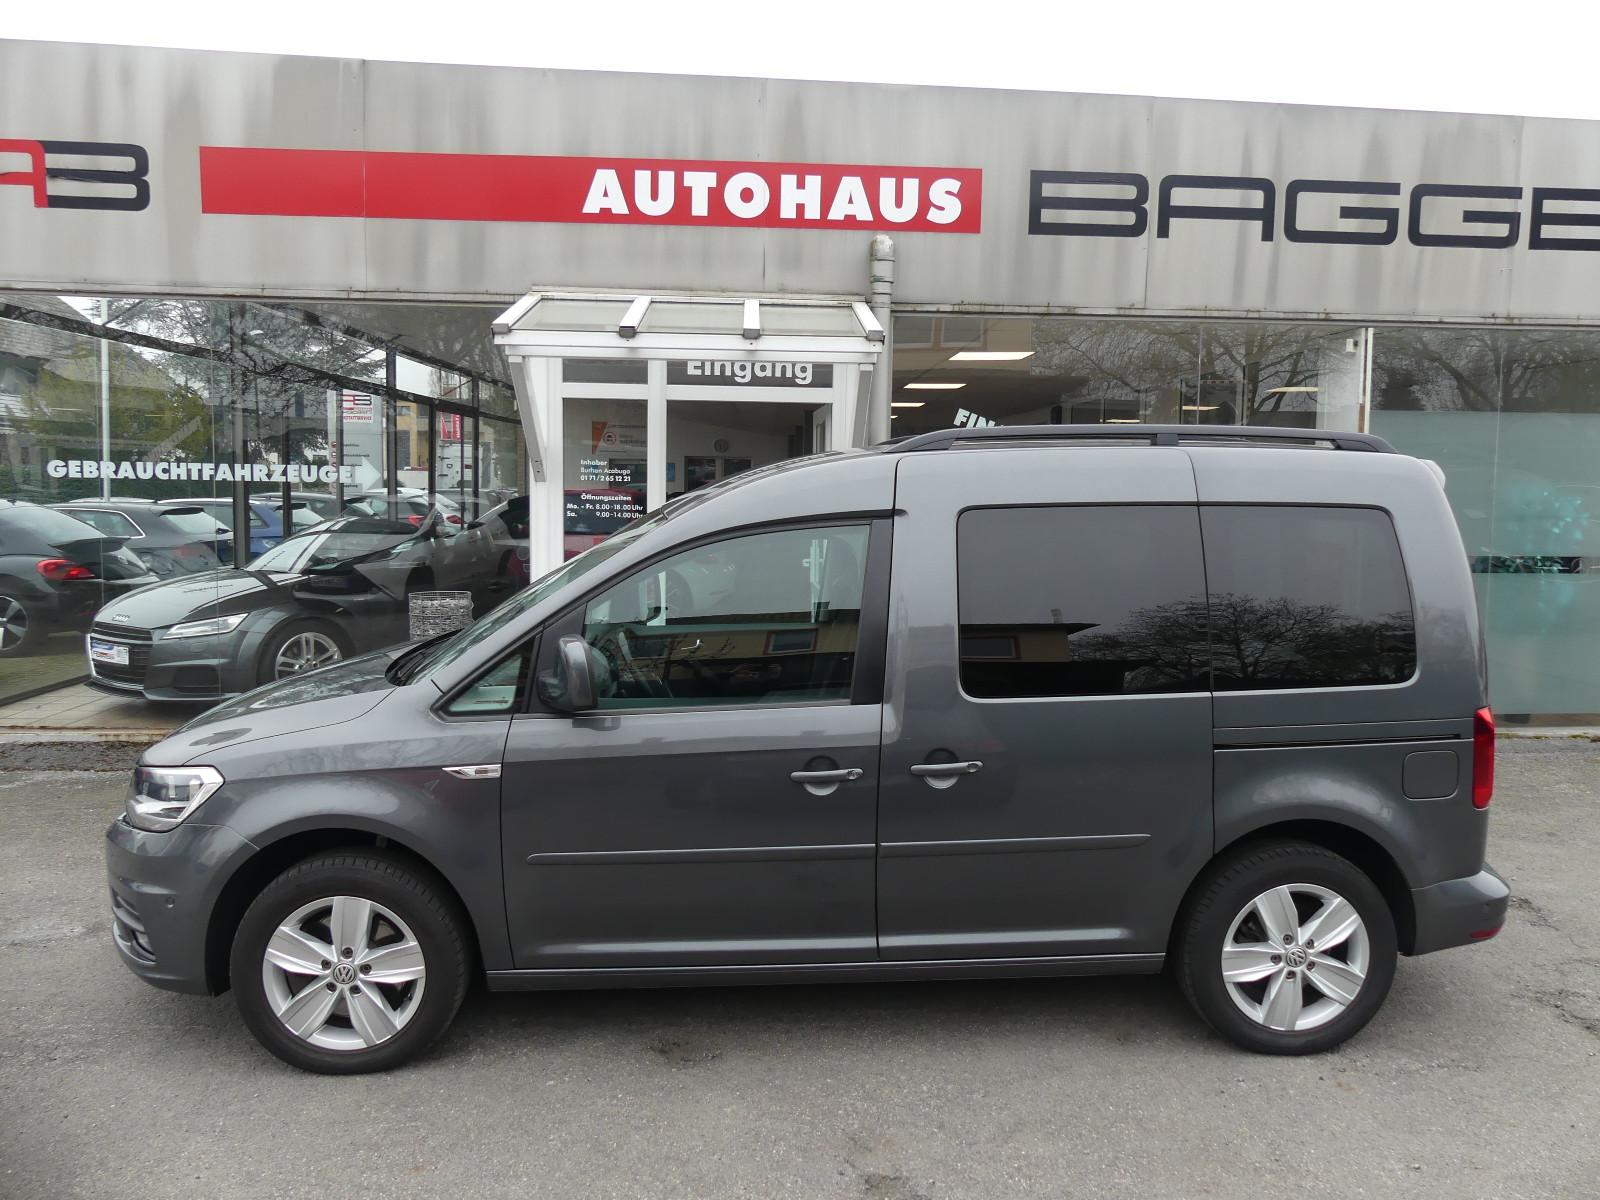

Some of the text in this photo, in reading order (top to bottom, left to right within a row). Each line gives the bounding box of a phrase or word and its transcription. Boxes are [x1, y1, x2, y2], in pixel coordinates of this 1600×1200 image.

[582, 168, 963, 225] AUTOHAUS
[1028, 169, 1600, 251] BAGGE
[686, 360, 813, 385] Eingang
[46, 459, 353, 484] GEBRAUCHTFAHRZEUGE
[581, 493, 632, 502] Öffnungszeiten
